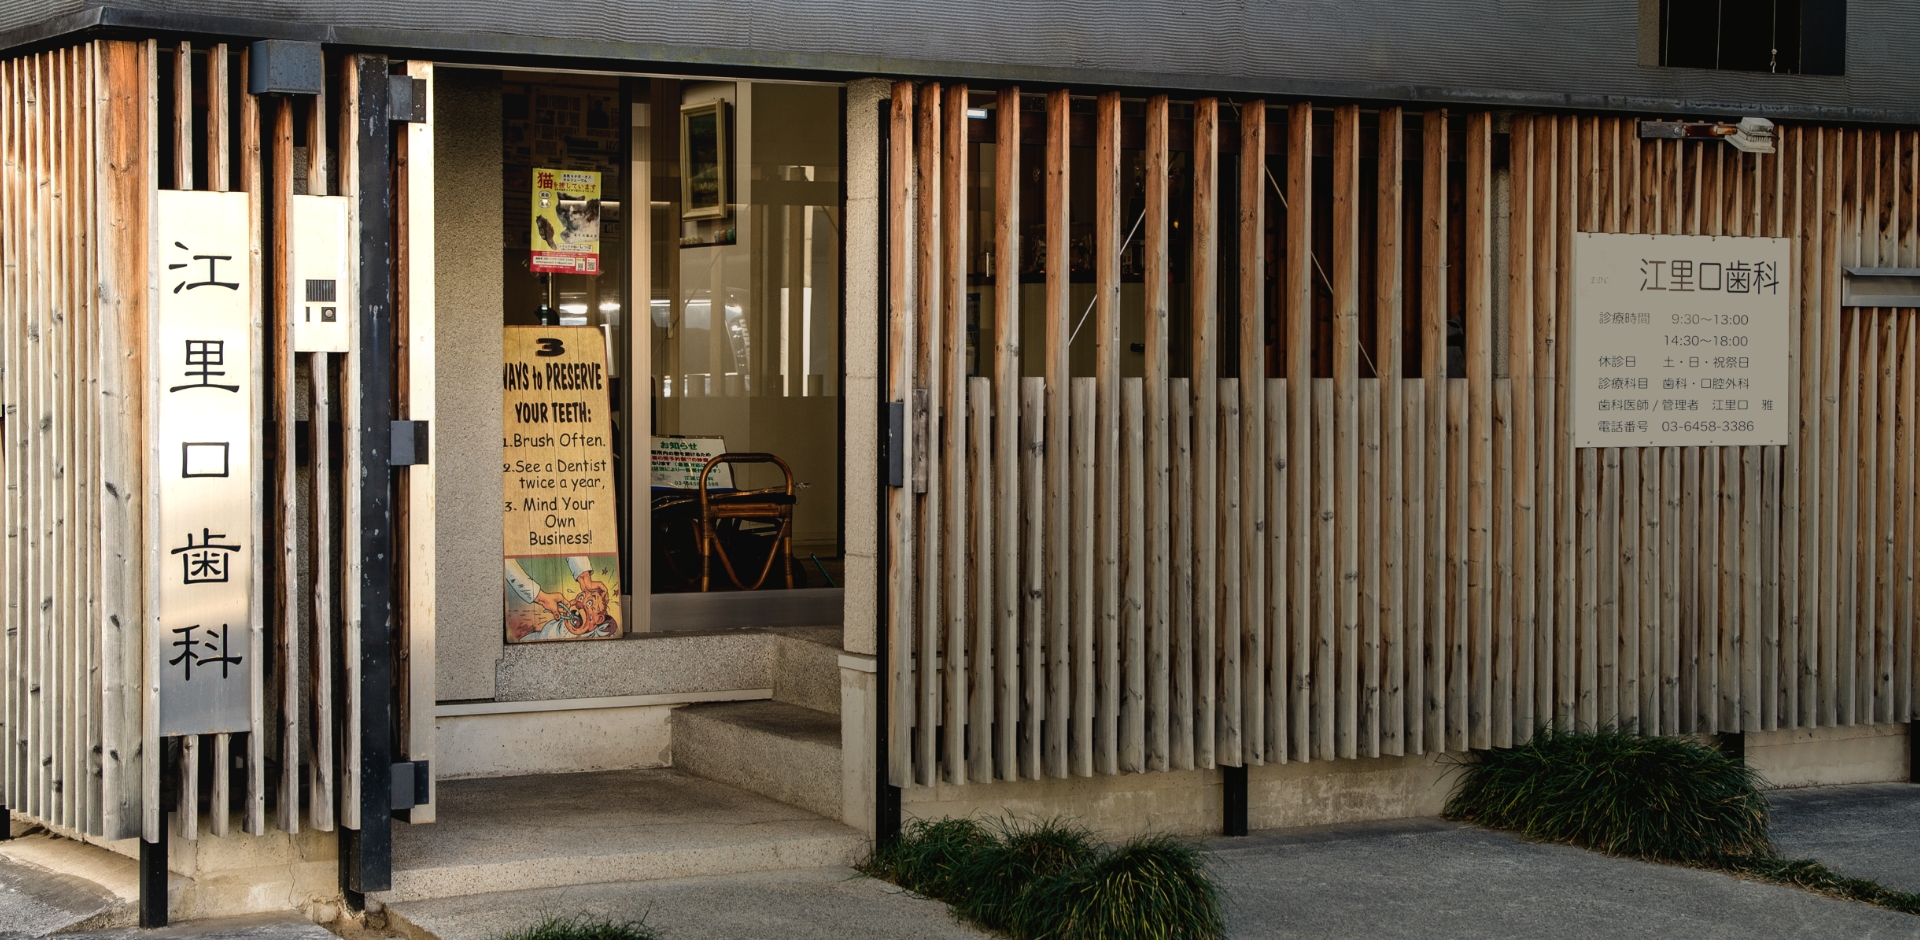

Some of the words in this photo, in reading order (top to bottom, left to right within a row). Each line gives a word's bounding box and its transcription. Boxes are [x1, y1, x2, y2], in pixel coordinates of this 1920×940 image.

[1639, 258, 1780, 295] 江里口歯科
[1598, 311, 1650, 325] 診療時間
[535, 337, 566, 357] 3
[1598, 356, 1636, 368] 休診日
[1662, 356, 1749, 369] 土・日・祝祭日
[532, 365, 543, 391] to
[546, 361, 603, 392] PRESERVE
[1598, 377, 1649, 390] 診療科目
[1662, 377, 1750, 390] 歯科・口腔外科
[1711, 399, 1749, 411] 江里口
[1761, 399, 1774, 411] 雅
[515, 401, 548, 424] YOUR
[551, 401, 592, 424] TEETH:
[1598, 420, 1649, 433] 電話番号
[1661, 420, 1755, 432] 03-6458-3386
[559, 433, 606, 448] Often.
[660, 441, 697, 450] お知らせ
[168, 241, 243, 682] 江里口歯科
[545, 463, 553, 472] a
[557, 459, 607, 472] Dentist
[519, 476, 556, 489] twice
[559, 478, 568, 489] a
[504, 501, 518, 513] 3.
[523, 497, 557, 511] Mind
[562, 497, 595, 511] Your
[545, 514, 576, 528] Own
[529, 530, 593, 546] Business!
